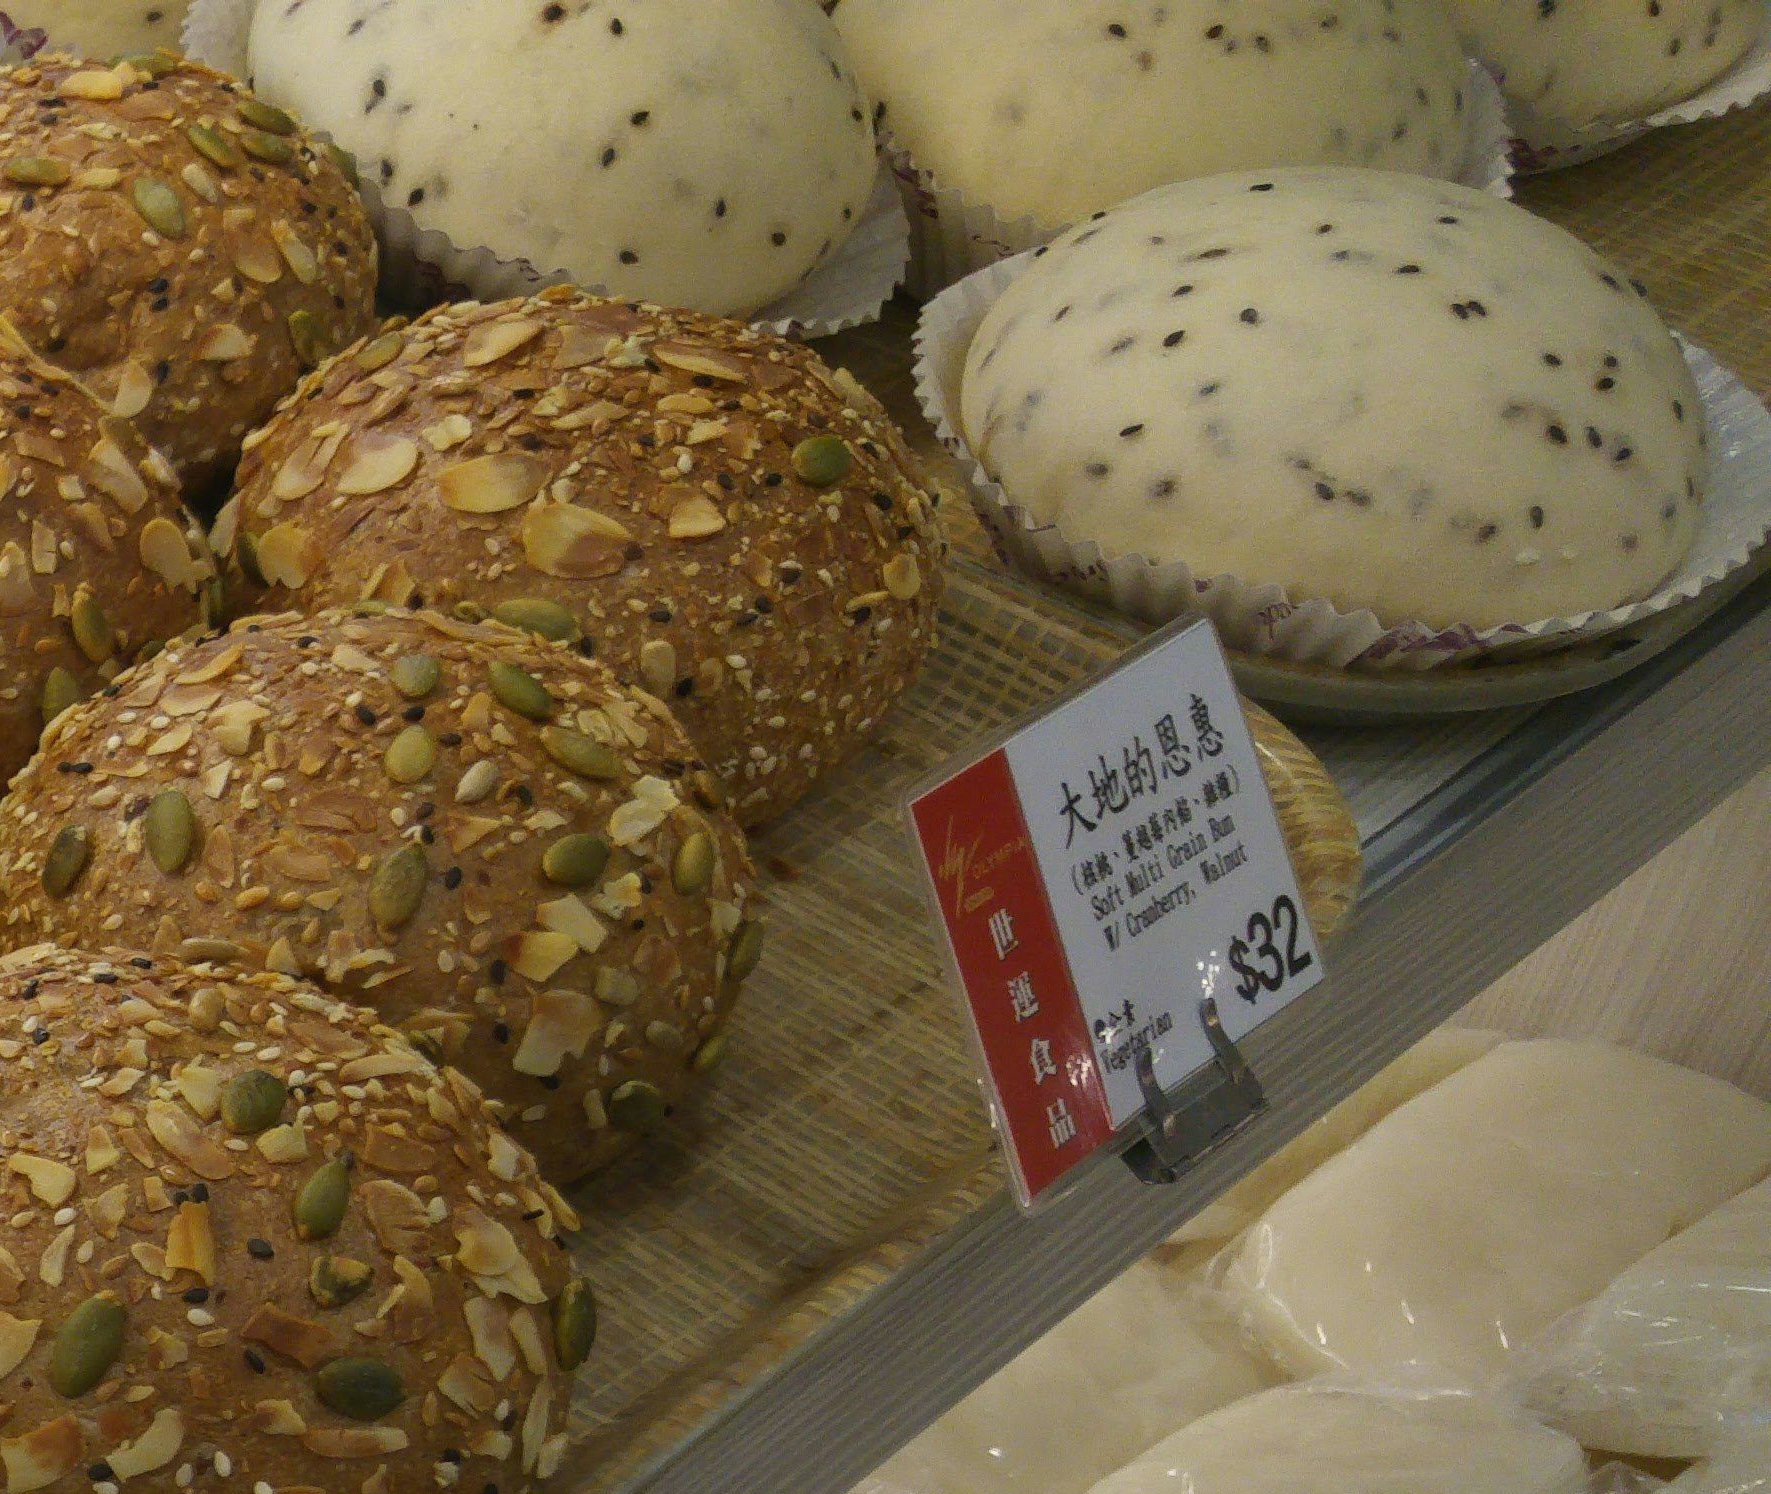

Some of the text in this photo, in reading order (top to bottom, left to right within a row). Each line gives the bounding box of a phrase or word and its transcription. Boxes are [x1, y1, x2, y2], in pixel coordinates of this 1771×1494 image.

[1059, 692, 1225, 849] 大地的恩惠
[1091, 814, 1236, 921] Soft Multi Grain Bun
[1200, 840, 1248, 885] Walnut
[1228, 894, 1313, 1005] $32
[987, 907, 1077, 1150] 世運食品
